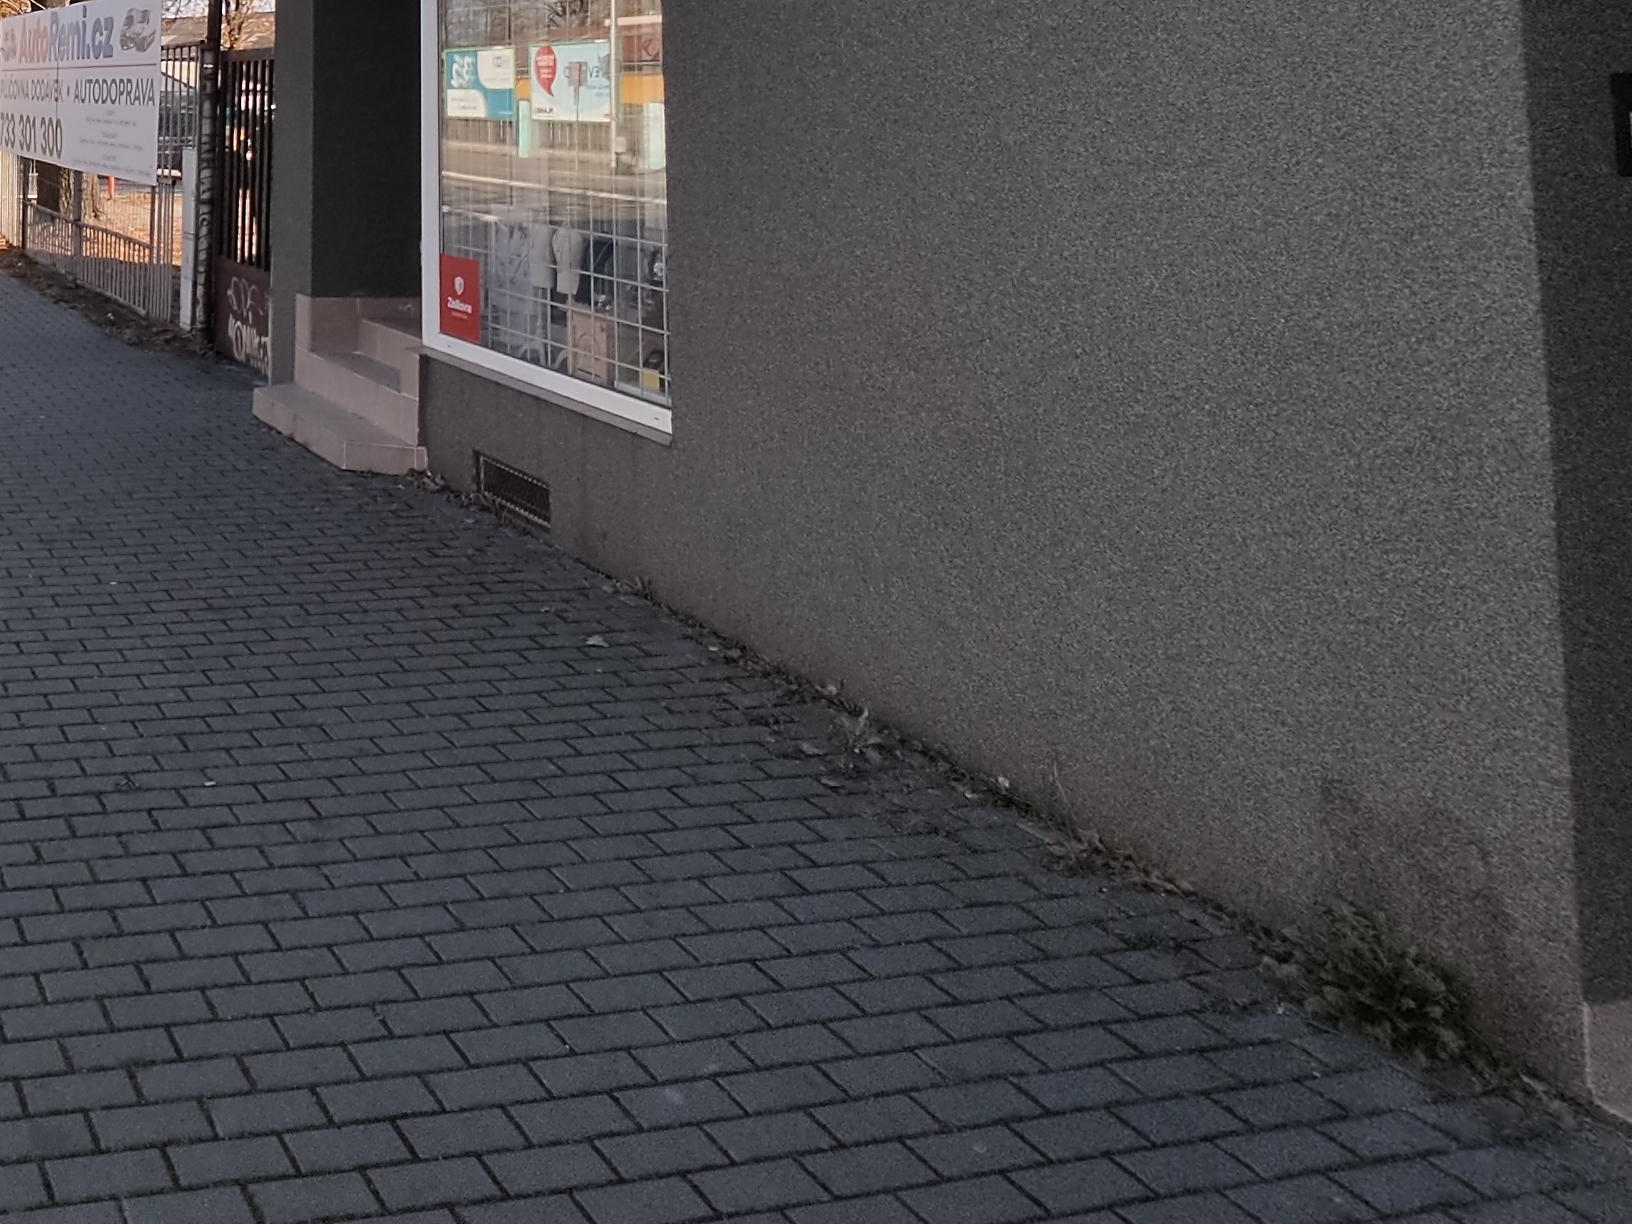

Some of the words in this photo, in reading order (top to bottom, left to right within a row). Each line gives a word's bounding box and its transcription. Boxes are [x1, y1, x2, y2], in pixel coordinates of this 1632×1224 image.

[73, 78, 156, 107] AUTODOPRAVA
[18, 114, 37, 154] 301
[40, 116, 63, 159] 300
